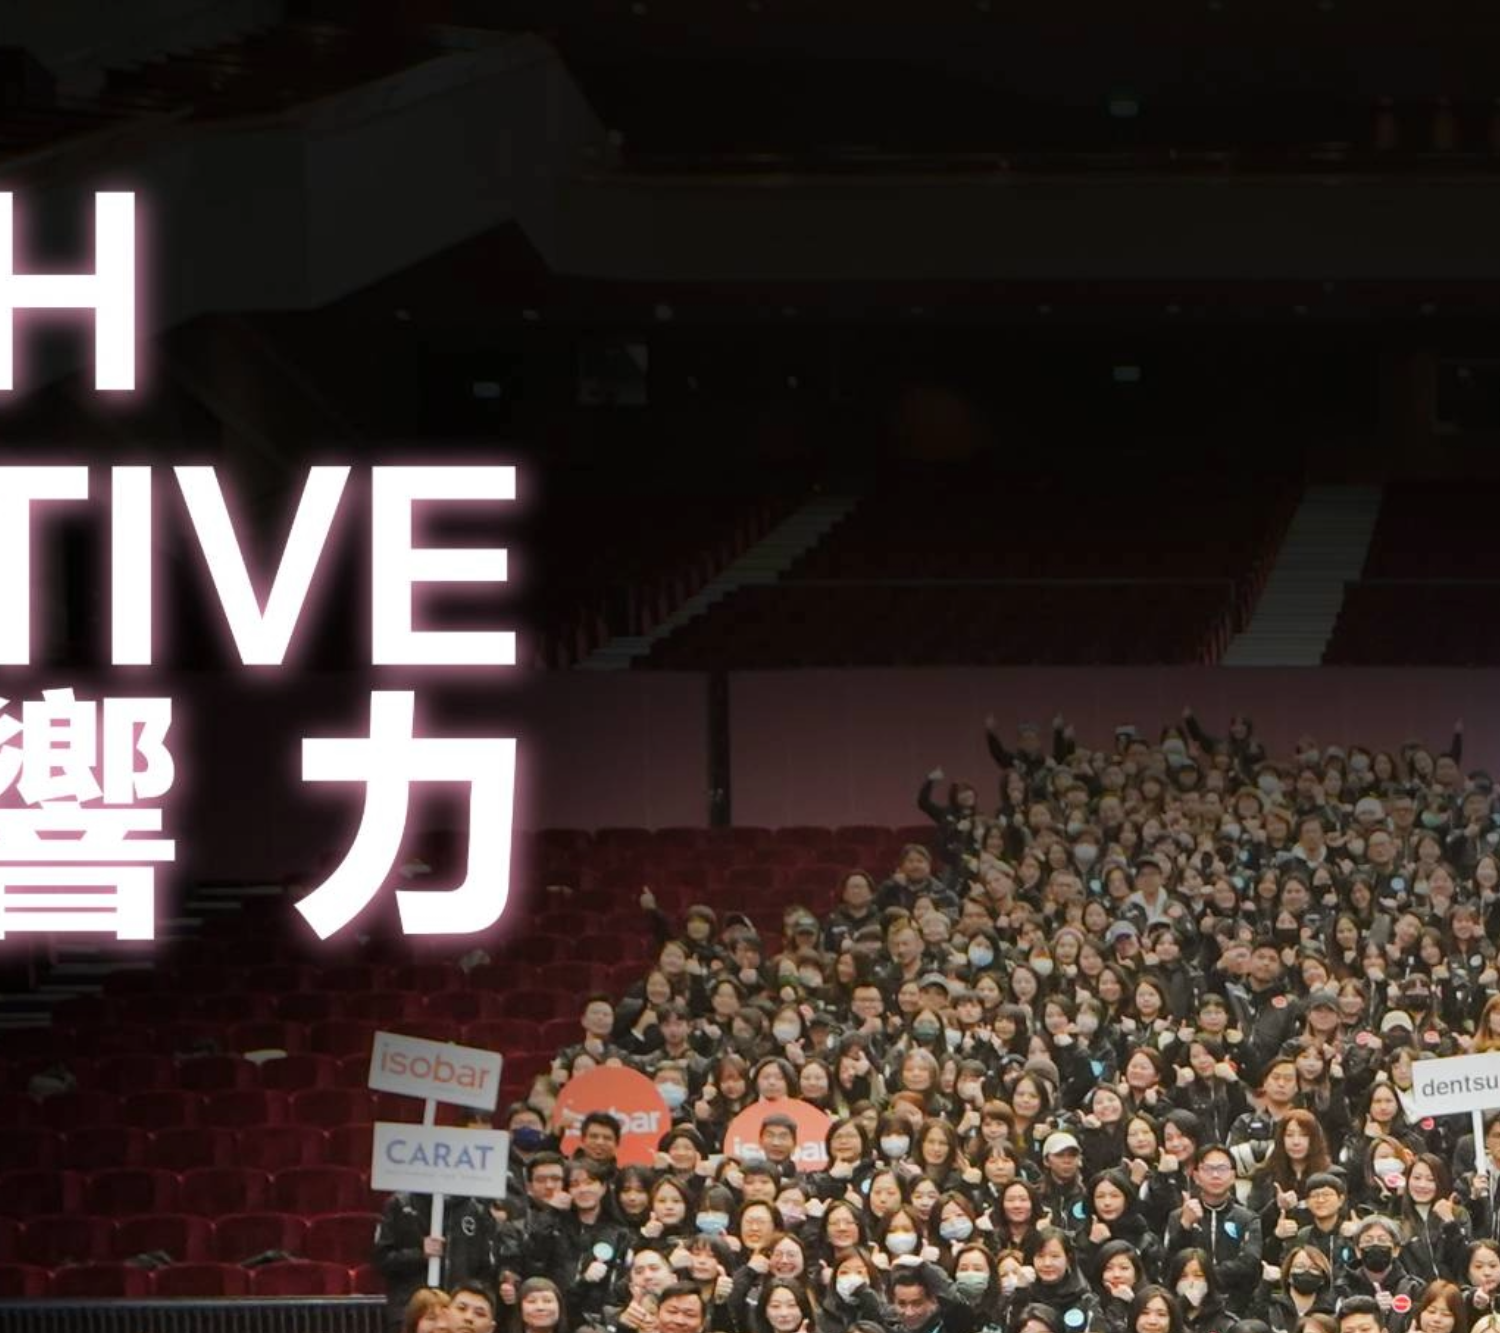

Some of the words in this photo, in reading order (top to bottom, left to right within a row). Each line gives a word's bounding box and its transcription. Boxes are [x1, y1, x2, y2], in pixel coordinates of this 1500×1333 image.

[381, 1046, 490, 1090] isobar
[1421, 1075, 1500, 1097] dentsu
[386, 1140, 495, 1171] CARAT
